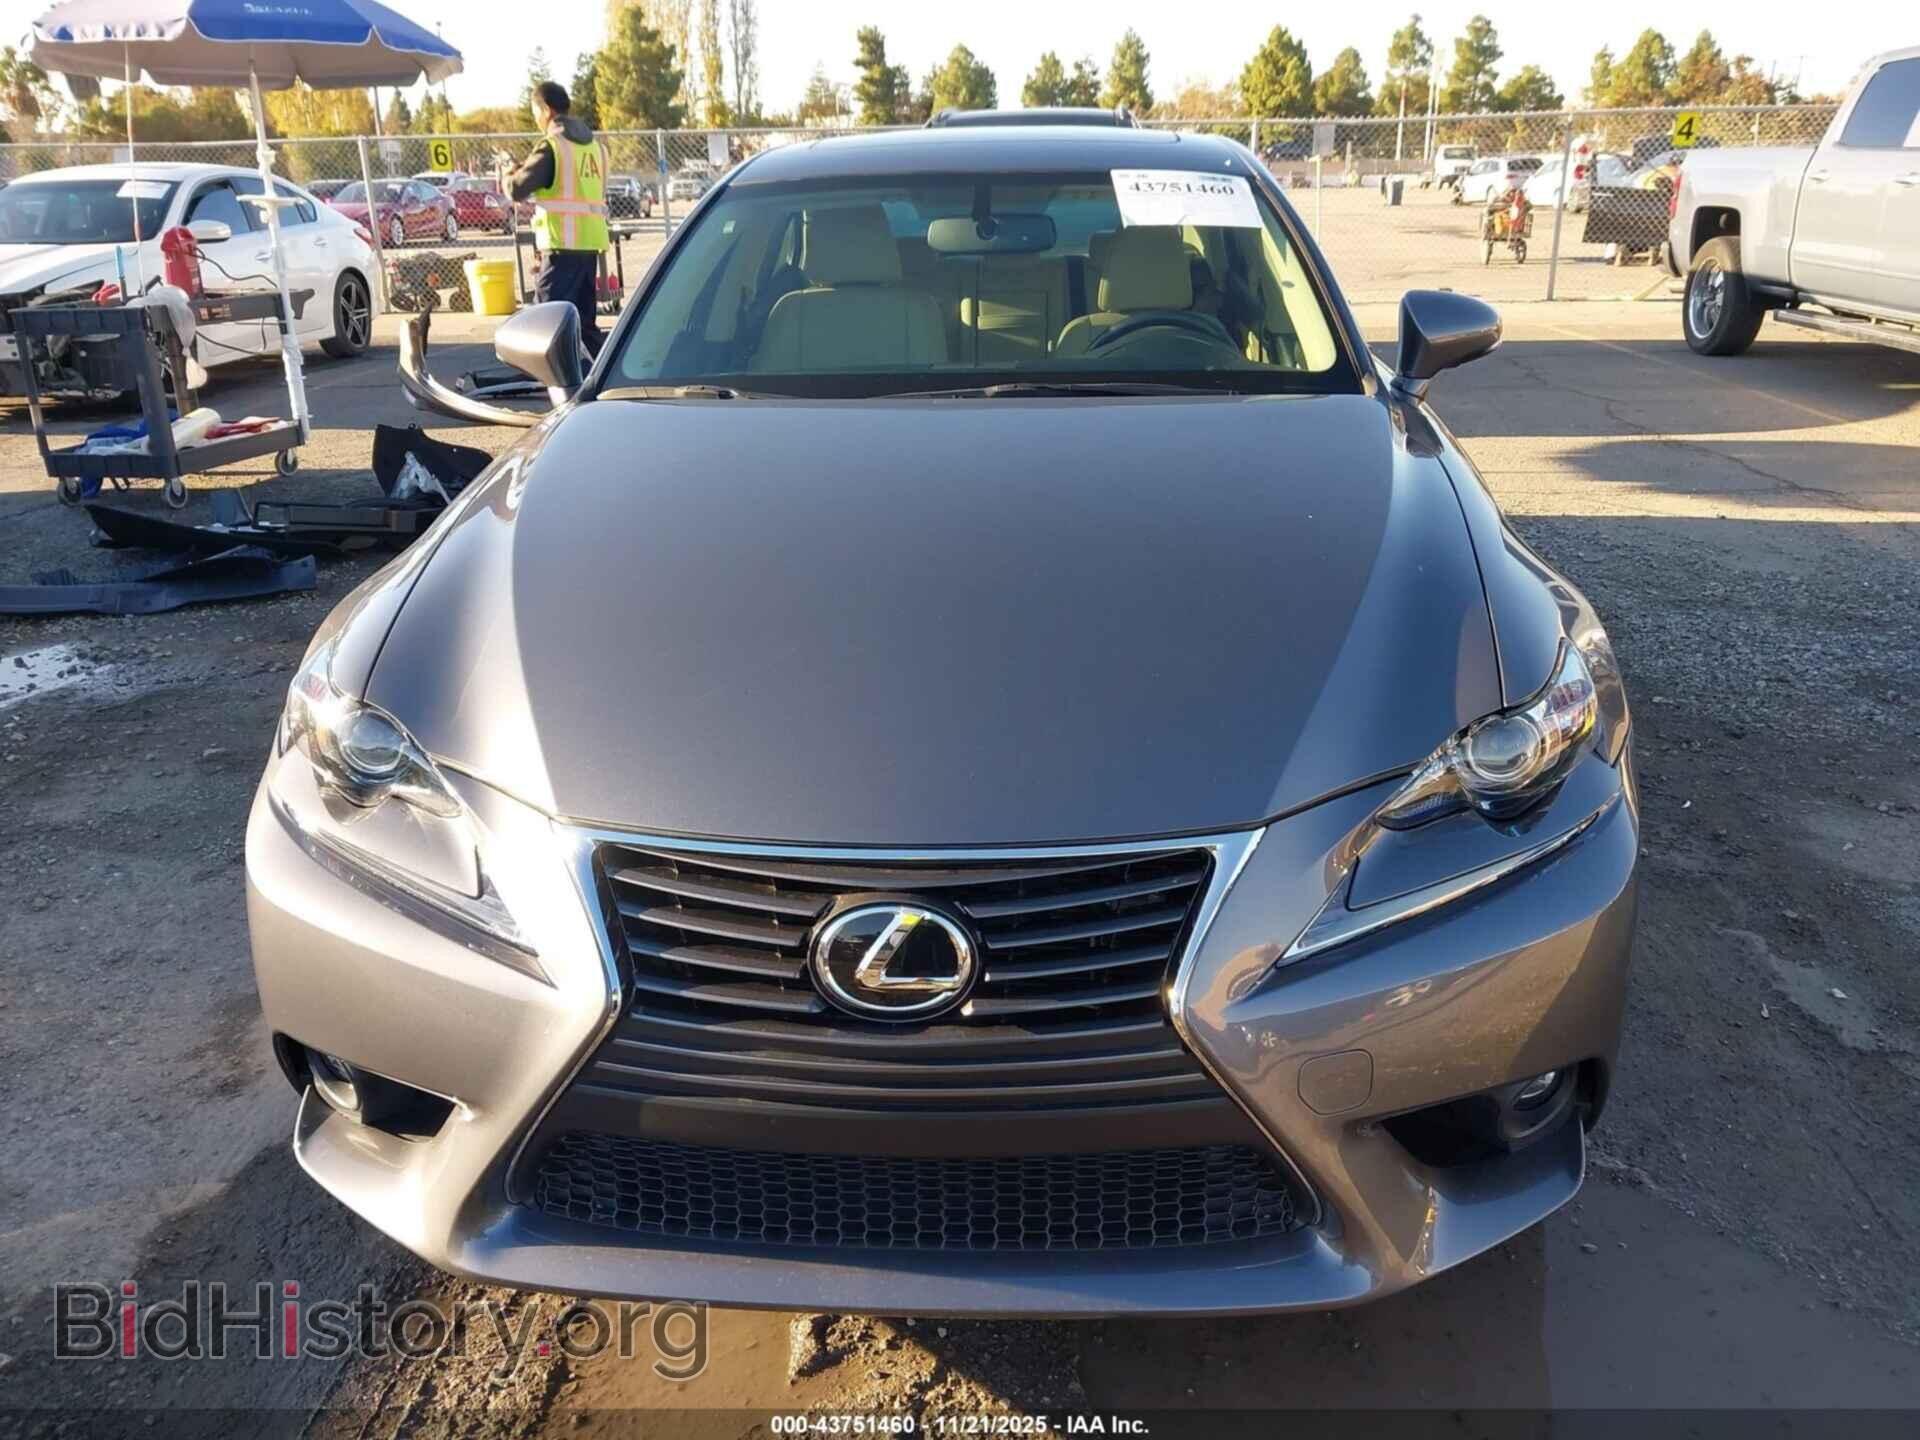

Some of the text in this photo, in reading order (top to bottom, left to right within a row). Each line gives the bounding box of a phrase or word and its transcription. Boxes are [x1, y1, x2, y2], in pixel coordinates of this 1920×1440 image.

[1677, 117, 1694, 140] 4
[434, 144, 449, 166] 6
[1129, 181, 1235, 195] 43751460
